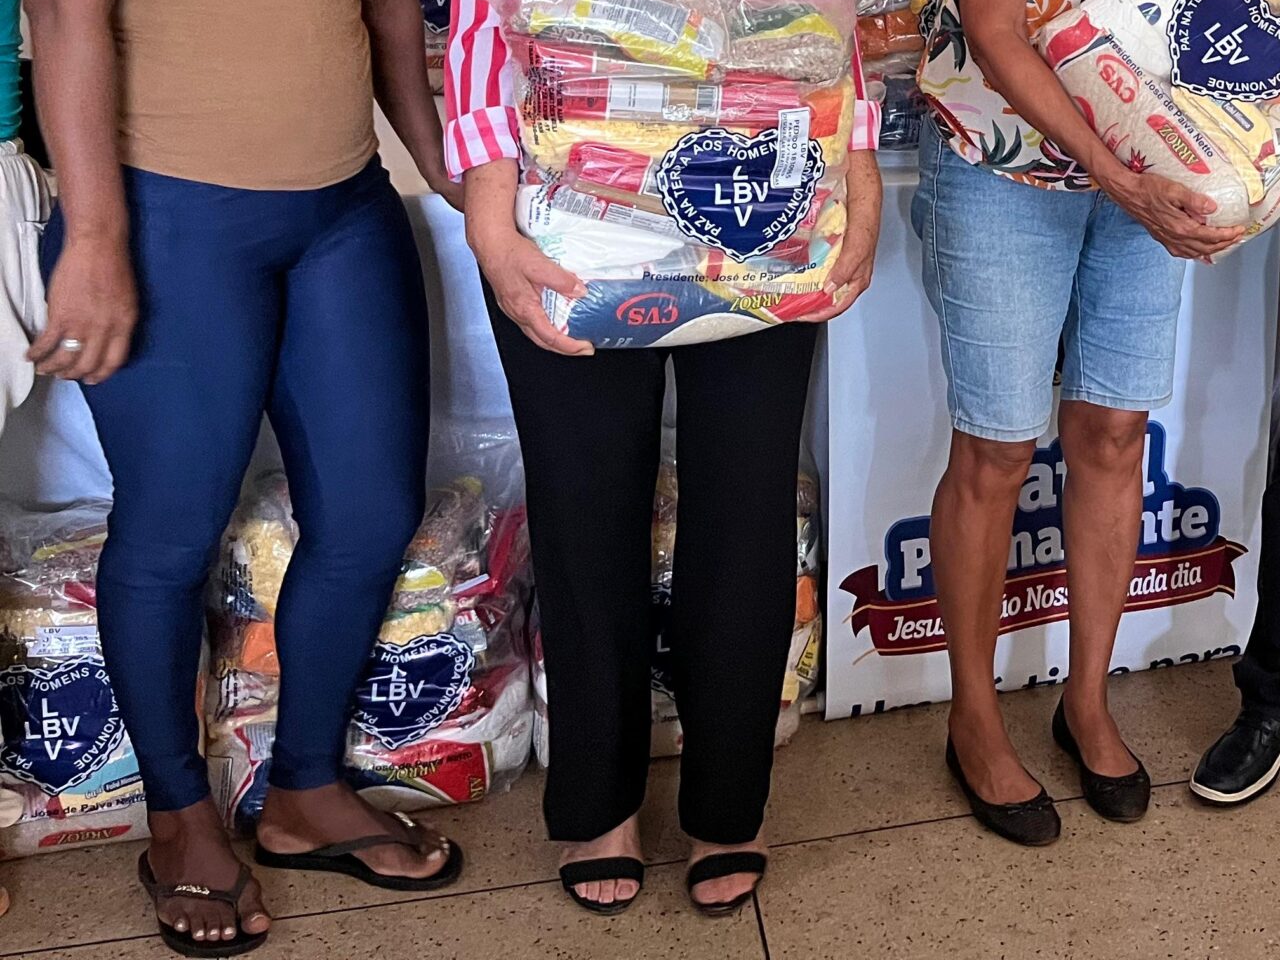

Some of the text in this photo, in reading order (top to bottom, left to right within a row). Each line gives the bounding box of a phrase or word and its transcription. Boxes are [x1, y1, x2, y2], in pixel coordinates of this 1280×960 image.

[1181, 9, 1195, 26] NA
[1178, 28, 1191, 51] PAZ
[1203, 22, 1251, 65] LBV
[1105, 33, 1214, 158] Presidente: José de Paiva Netto
[1206, 76, 1268, 92] VONTADE
[791, 119, 800, 150] PEDIDO
[1158, 123, 1199, 165] ARROZ
[692, 140, 723, 156] AOS
[714, 181, 770, 206] LBV
[679, 198, 698, 218] NA
[694, 215, 723, 237] PAZ
[641, 271, 709, 283] Presidente:
[712, 272, 739, 283] José
[742, 272, 756, 282] de
[729, 292, 784, 312] ARROZ
[1169, 561, 1203, 588] dia
[380, 642, 438, 664] HOMENS
[450, 654, 465, 680] BOA
[370, 679, 426, 702] LBV
[414, 681, 461, 725] VONTADE
[5, 751, 33, 770] PAZ
[30, 666, 91, 692] HOMENS
[72, 716, 120, 771] VONTADE
[24, 715, 81, 740] LBV
